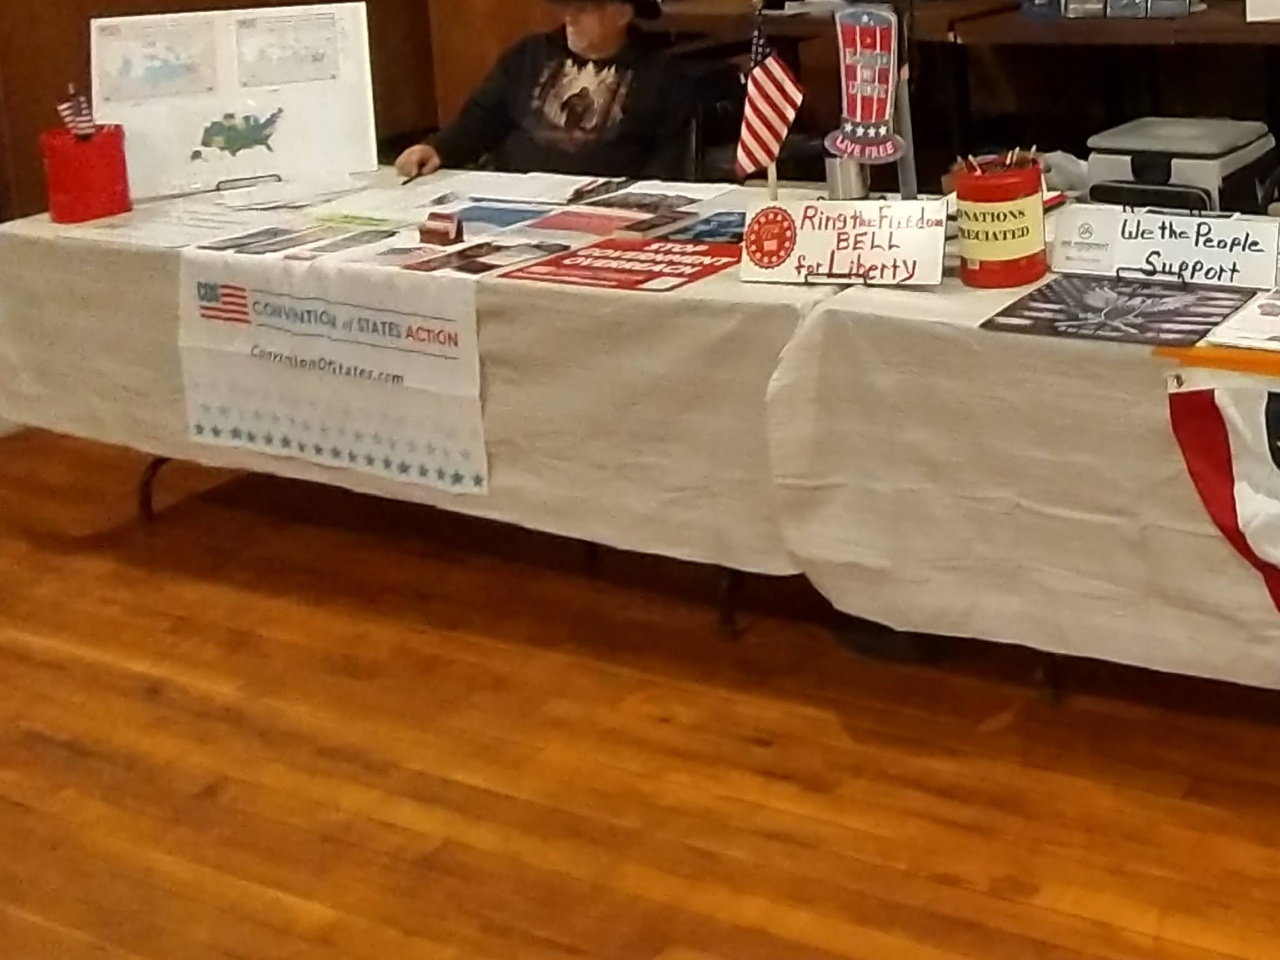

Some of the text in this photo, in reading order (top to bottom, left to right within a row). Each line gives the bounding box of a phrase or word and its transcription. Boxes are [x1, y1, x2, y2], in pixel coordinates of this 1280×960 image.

[835, 134, 895, 160] LIVE FREE
[800, 205, 848, 231] Ring
[849, 208, 879, 230] the
[956, 207, 1027, 223] ONATIONS
[643, 241, 711, 253] STOP
[835, 230, 902, 252] BELL
[1120, 218, 1267, 254] We the People
[562, 255, 704, 275] OVERREACH
[576, 246, 740, 267] GOVERNMENT
[794, 248, 918, 285] for Liberty
[356, 319, 403, 340] STATES
[405, 325, 460, 349] ACTION
